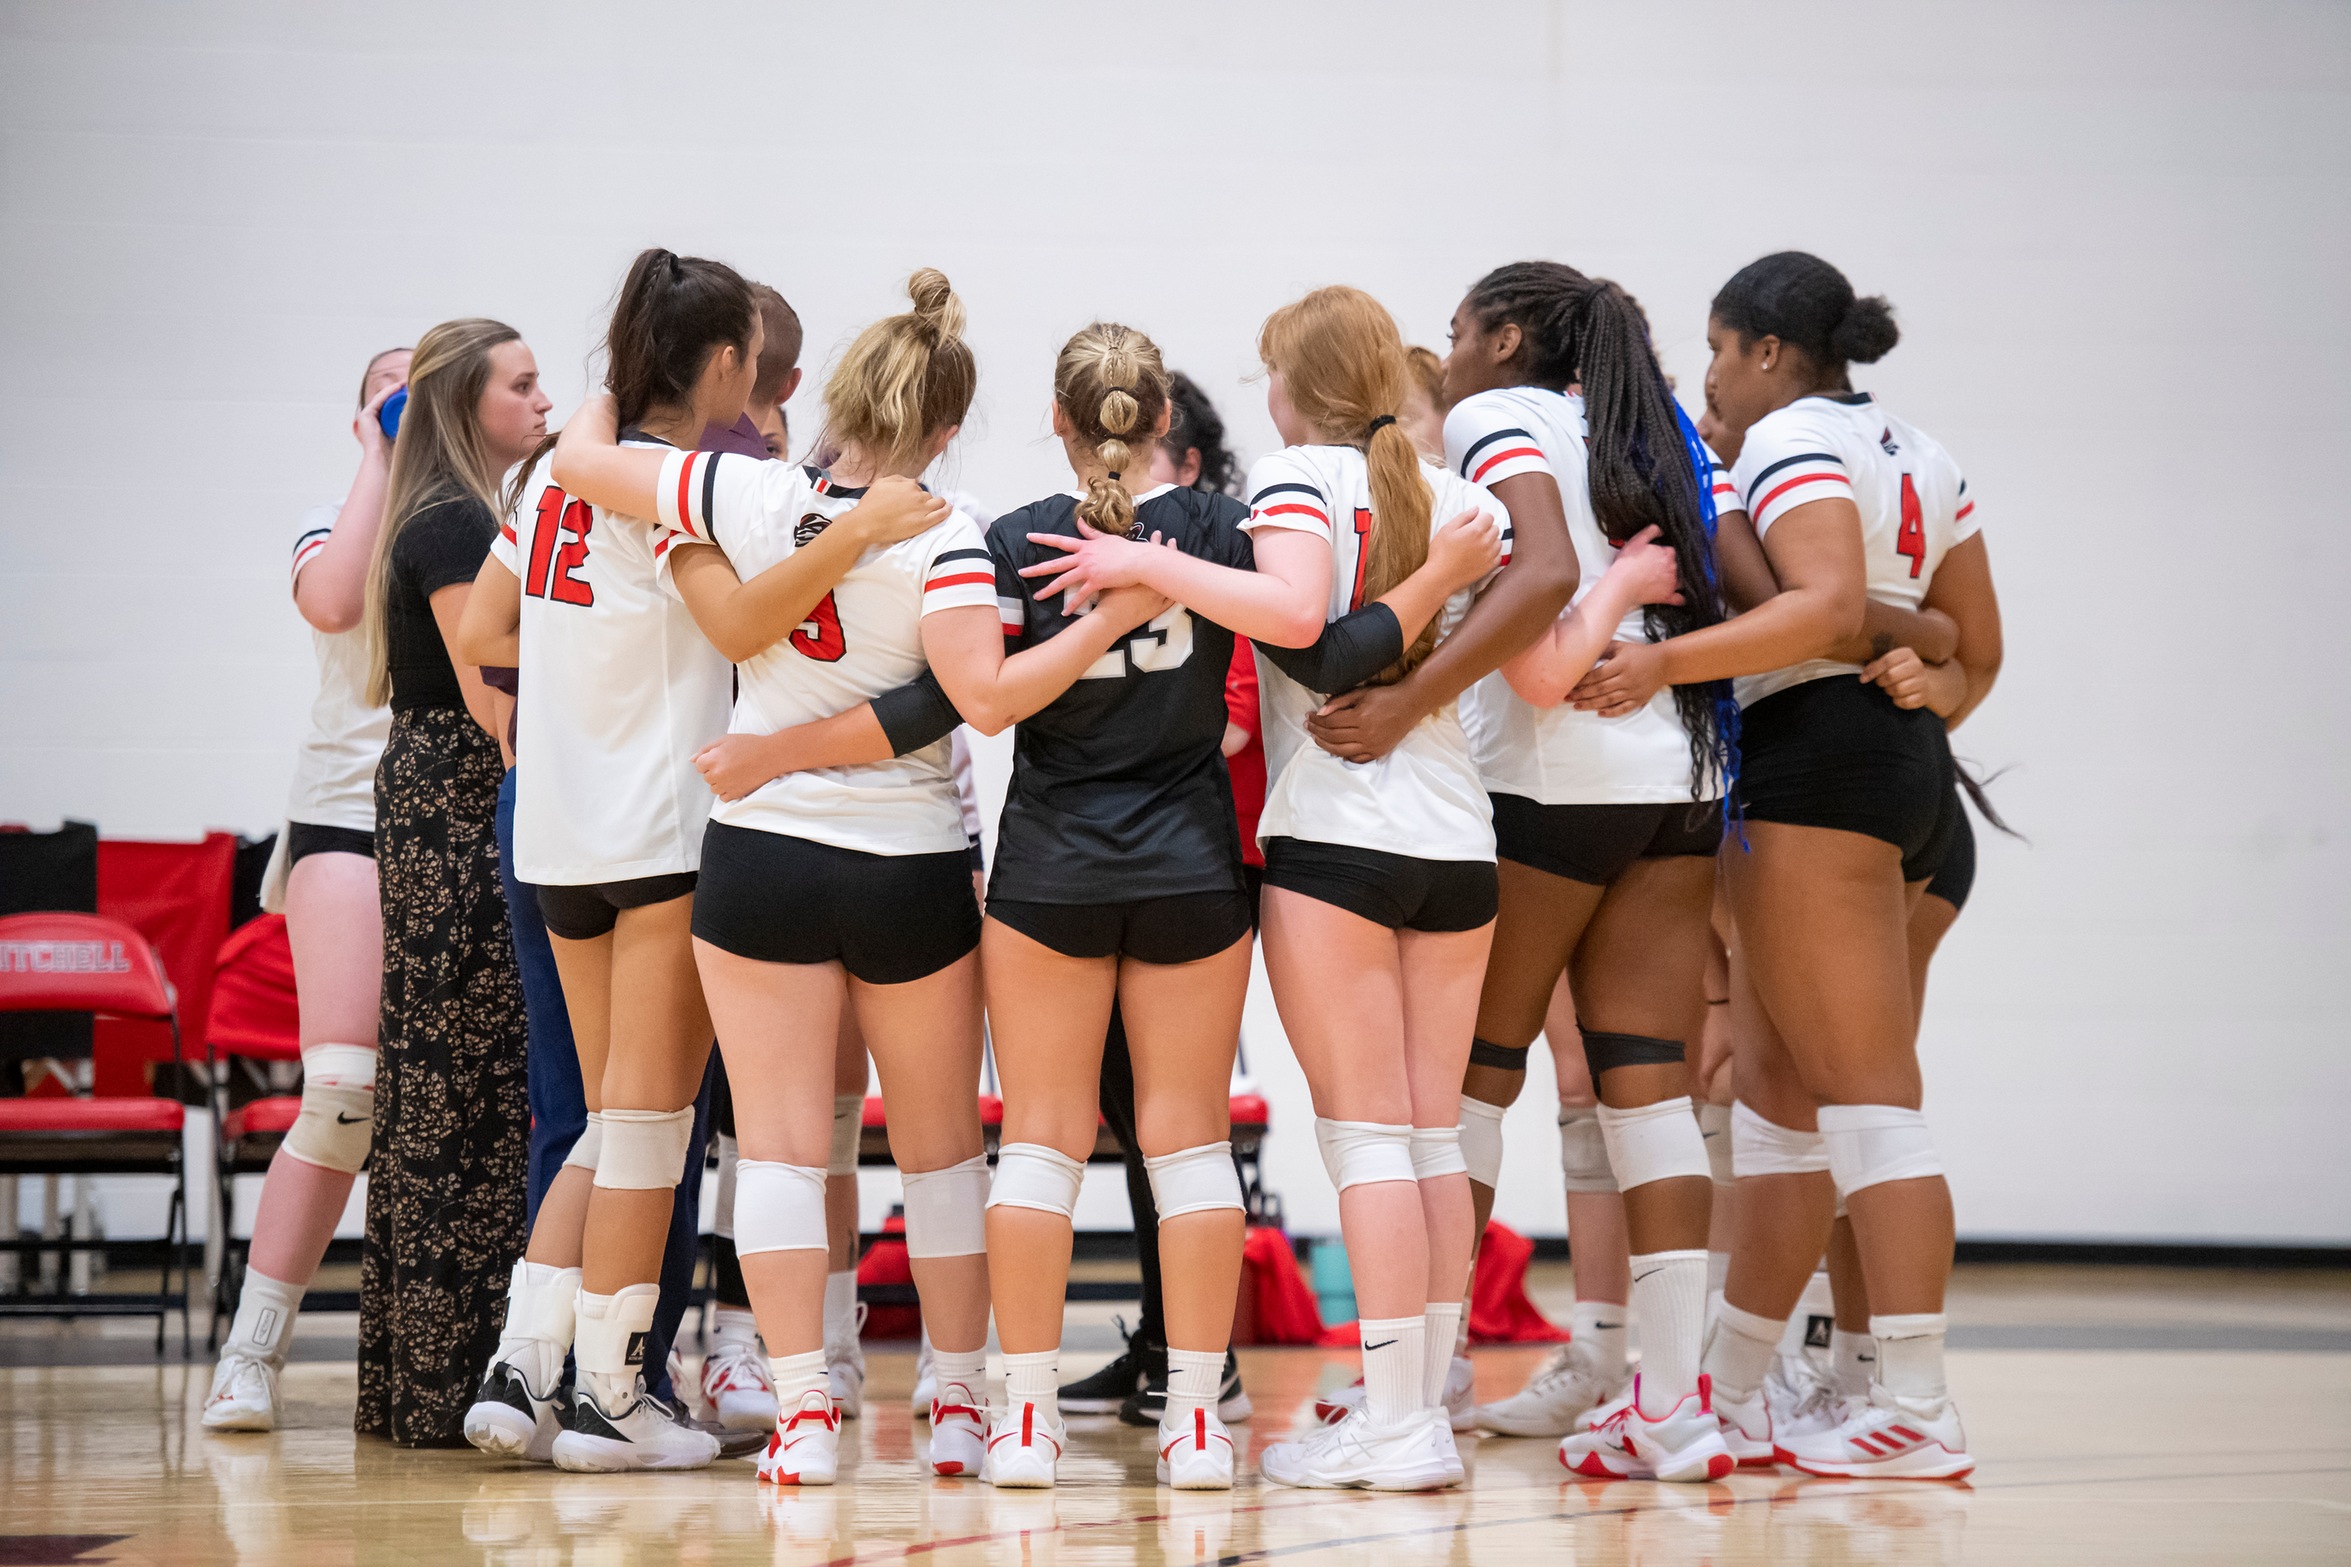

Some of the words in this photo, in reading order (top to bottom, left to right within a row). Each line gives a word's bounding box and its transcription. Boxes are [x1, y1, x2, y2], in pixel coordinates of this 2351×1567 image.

[525, 485, 594, 607] 12
[1896, 472, 1926, 578] 4
[0, 940, 131, 973] ITCHELL
